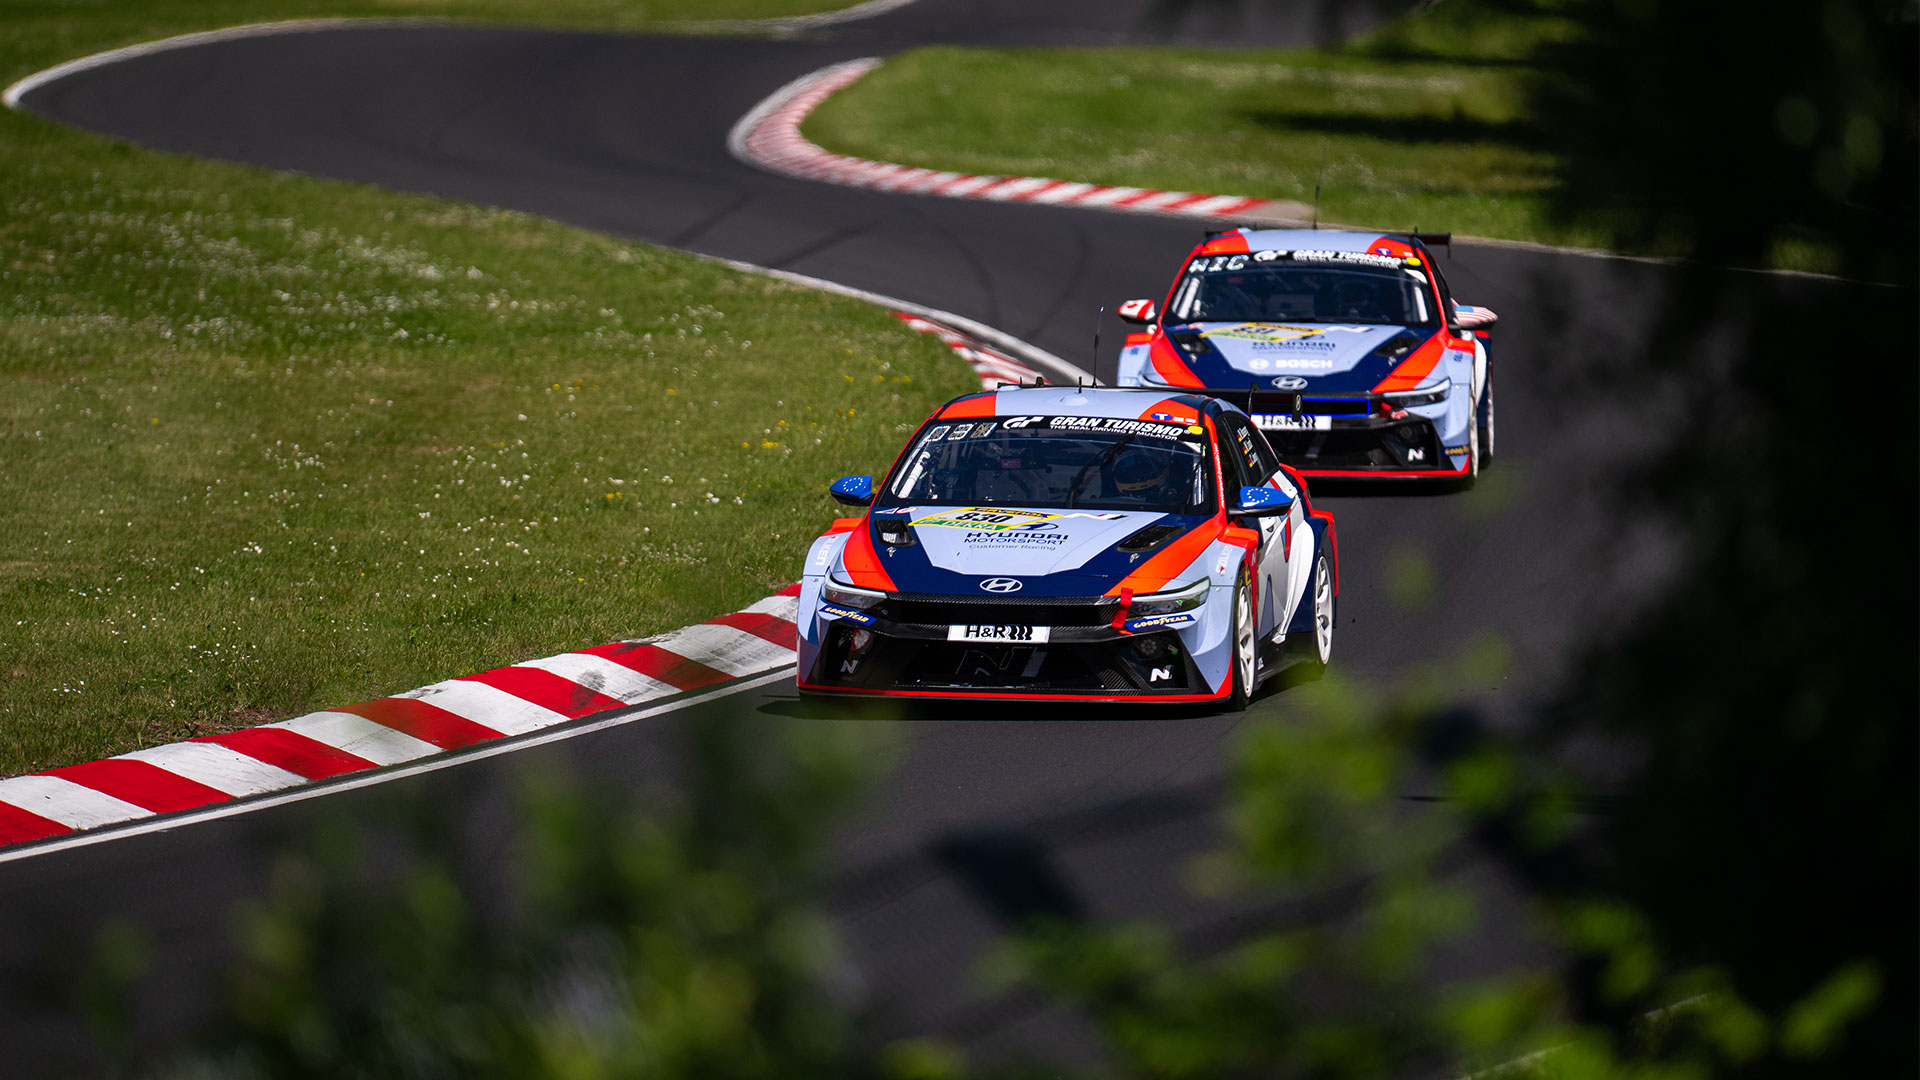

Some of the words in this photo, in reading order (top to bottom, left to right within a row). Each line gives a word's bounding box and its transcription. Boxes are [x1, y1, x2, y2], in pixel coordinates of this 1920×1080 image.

[1276, 359, 1333, 369] BOSCH
[1050, 415, 1103, 428] GRAN
[1104, 418, 1184, 437] TURISMO
[1091, 426, 1127, 434] DRIVING
[1127, 429, 1178, 441] SMULATOR
[955, 512, 1014, 523] 830
[942, 519, 998, 531] DEKRA
[966, 531, 1069, 540] HYUNDAI
[824, 607, 869, 623] GOODYEAR
[1133, 615, 1188, 629] GOODYEAR
[965, 624, 1006, 639] H&R
[1150, 665, 1175, 683] N
